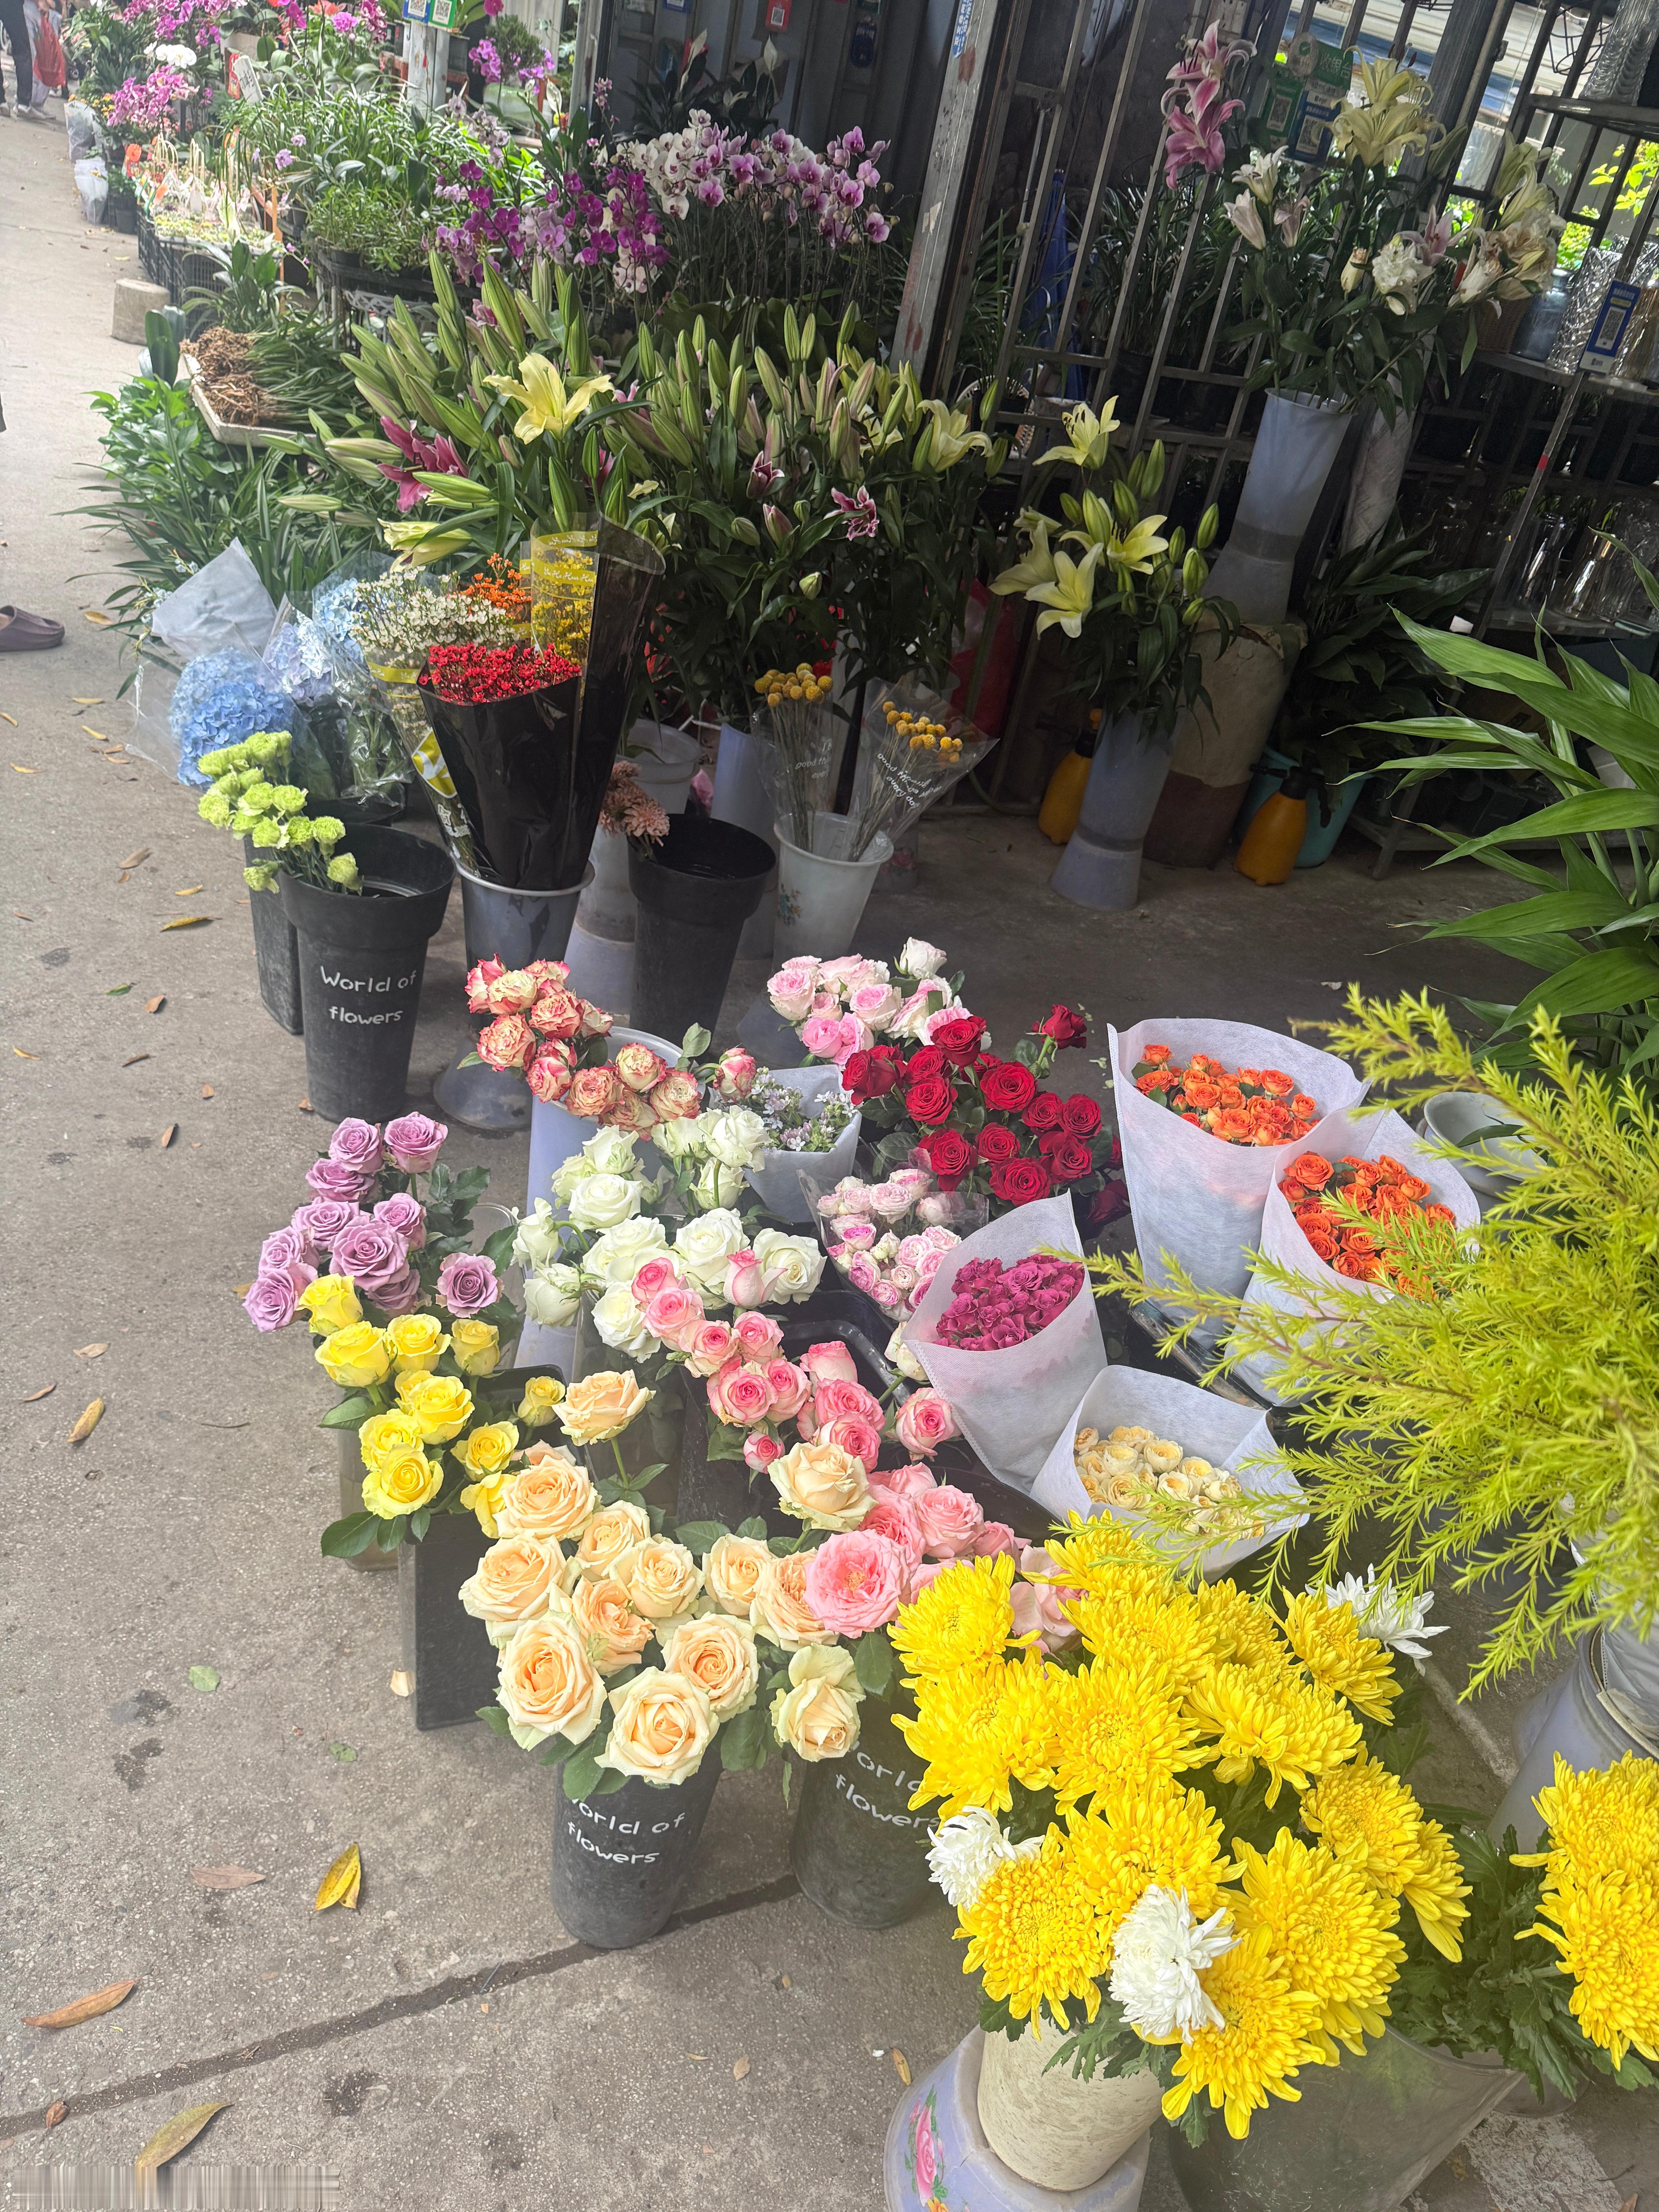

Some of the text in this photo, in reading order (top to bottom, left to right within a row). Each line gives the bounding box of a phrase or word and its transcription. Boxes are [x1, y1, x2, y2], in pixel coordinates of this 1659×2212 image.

[794, 758, 817, 770] good
[877, 753, 898, 772] good
[886, 776, 907, 797] every
[906, 795, 920, 809] day
[320, 965, 417, 993] World of
[329, 1005, 404, 1025] flowers
[850, 1740, 921, 1792] orl
[571, 1798, 685, 1835] orld of
[835, 1773, 941, 1828] flowers
[567, 1821, 660, 1864] flowers
